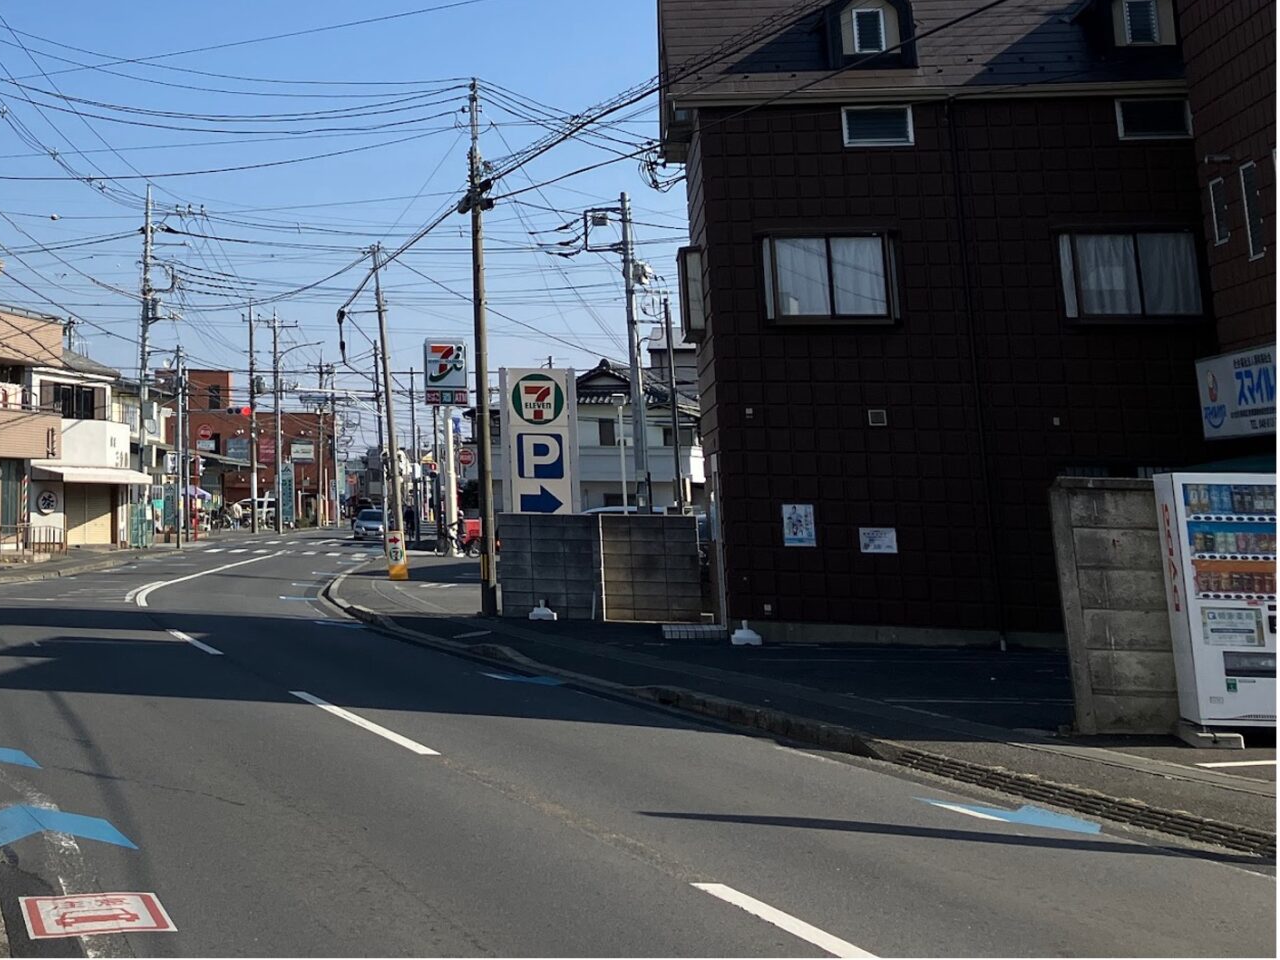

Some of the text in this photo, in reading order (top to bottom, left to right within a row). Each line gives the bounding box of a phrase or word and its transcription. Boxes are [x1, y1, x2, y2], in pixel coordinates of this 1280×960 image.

[1235, 365, 1276, 406] スマイル
[523, 434, 561, 478] P
